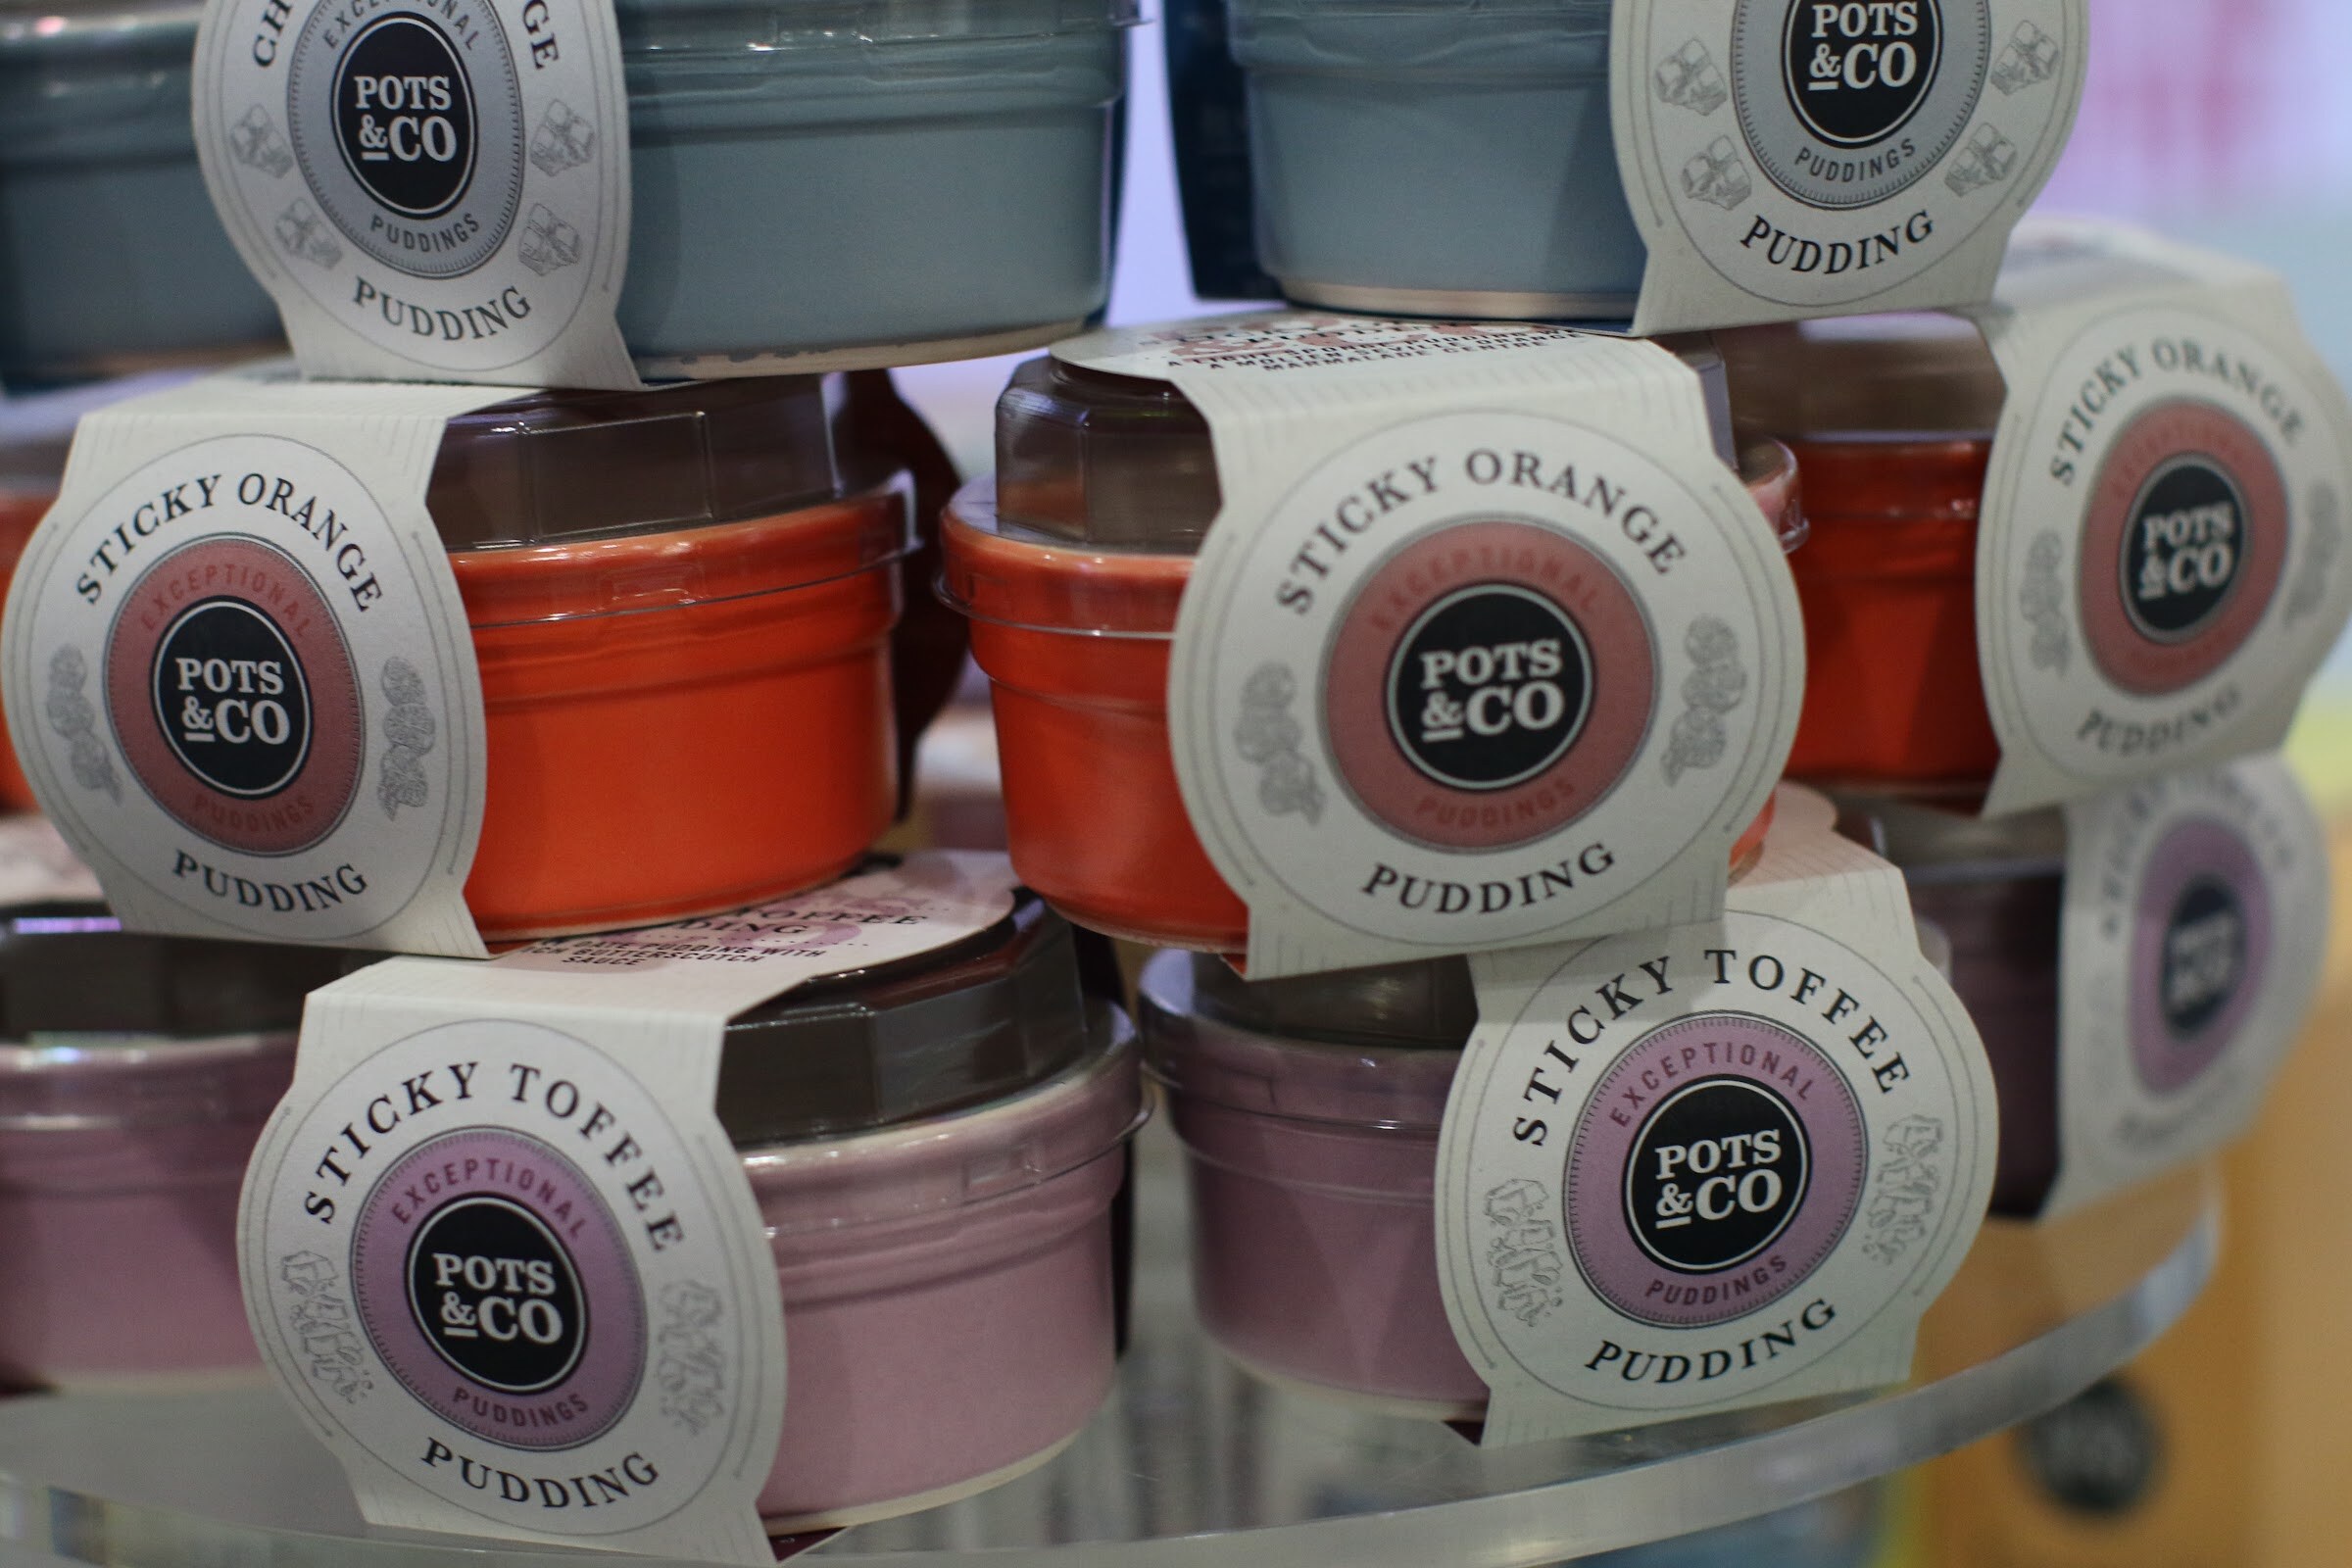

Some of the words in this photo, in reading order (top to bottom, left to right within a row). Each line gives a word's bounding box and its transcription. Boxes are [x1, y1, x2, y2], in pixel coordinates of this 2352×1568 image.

[323, 0, 478, 49] EXCNAL
[1811, 2, 1918, 37] POTS
[1808, 41, 1917, 90] &CO
[355, 76, 452, 111] POTS
[359, 115, 458, 162] &CO
[1795, 138, 1917, 183] PUDDINGS
[369, 213, 480, 253] PUDDINGS
[1740, 209, 1936, 275] PUDDING
[353, 276, 532, 341] PUDDING
[1263, 350, 1432, 370] MARMALADE
[1354, 342, 1464, 355] SEVILLE
[1476, 333, 1584, 345] ORANGE
[2050, 345, 2141, 487] STICKY
[2151, 337, 2303, 444] ORANGE
[76, 473, 223, 607] STICKY
[236, 472, 382, 612] ORANGE
[1277, 457, 1440, 616] STICKY
[1464, 448, 1688, 576] ORANGE
[2142, 501, 2233, 551] POTS
[141, 562, 312, 638] EXCEPTIONAL
[175, 658, 284, 696] POTS
[1420, 639, 1563, 690] POTS
[181, 697, 290, 745] &CO
[1421, 683, 1564, 743] &CO
[196, 792, 316, 831] PUDDINGS
[1414, 781, 1577, 827] PUDDINGS
[172, 849, 369, 913] PUDDING
[1361, 841, 1617, 915] PUDDING
[562, 956, 647, 966] SAUCE
[572, 949, 765, 962] BUTTERSCOTCH
[641, 943, 754, 955] PUDDING
[760, 948, 827, 957] WITH
[1512, 956, 1675, 1147] STICKY
[1703, 949, 1912, 1095] TOFFEE
[1609, 1041, 1814, 1129] EXCEPTIONAL
[304, 1061, 481, 1224] STICKY
[509, 1063, 684, 1253] TOFFEE
[1654, 1128, 1782, 1181] POTS
[392, 1156, 585, 1241] EXCEPTIONAL
[1655, 1169, 1784, 1230] &CO
[431, 1251, 556, 1297] POTS
[1643, 1254, 1788, 1307] PUDDINGS
[440, 1292, 564, 1344] &CO
[1585, 1298, 1838, 1384] PUDDING
[451, 1387, 588, 1428] PUDDINGS
[420, 1436, 661, 1508] PUDDING
